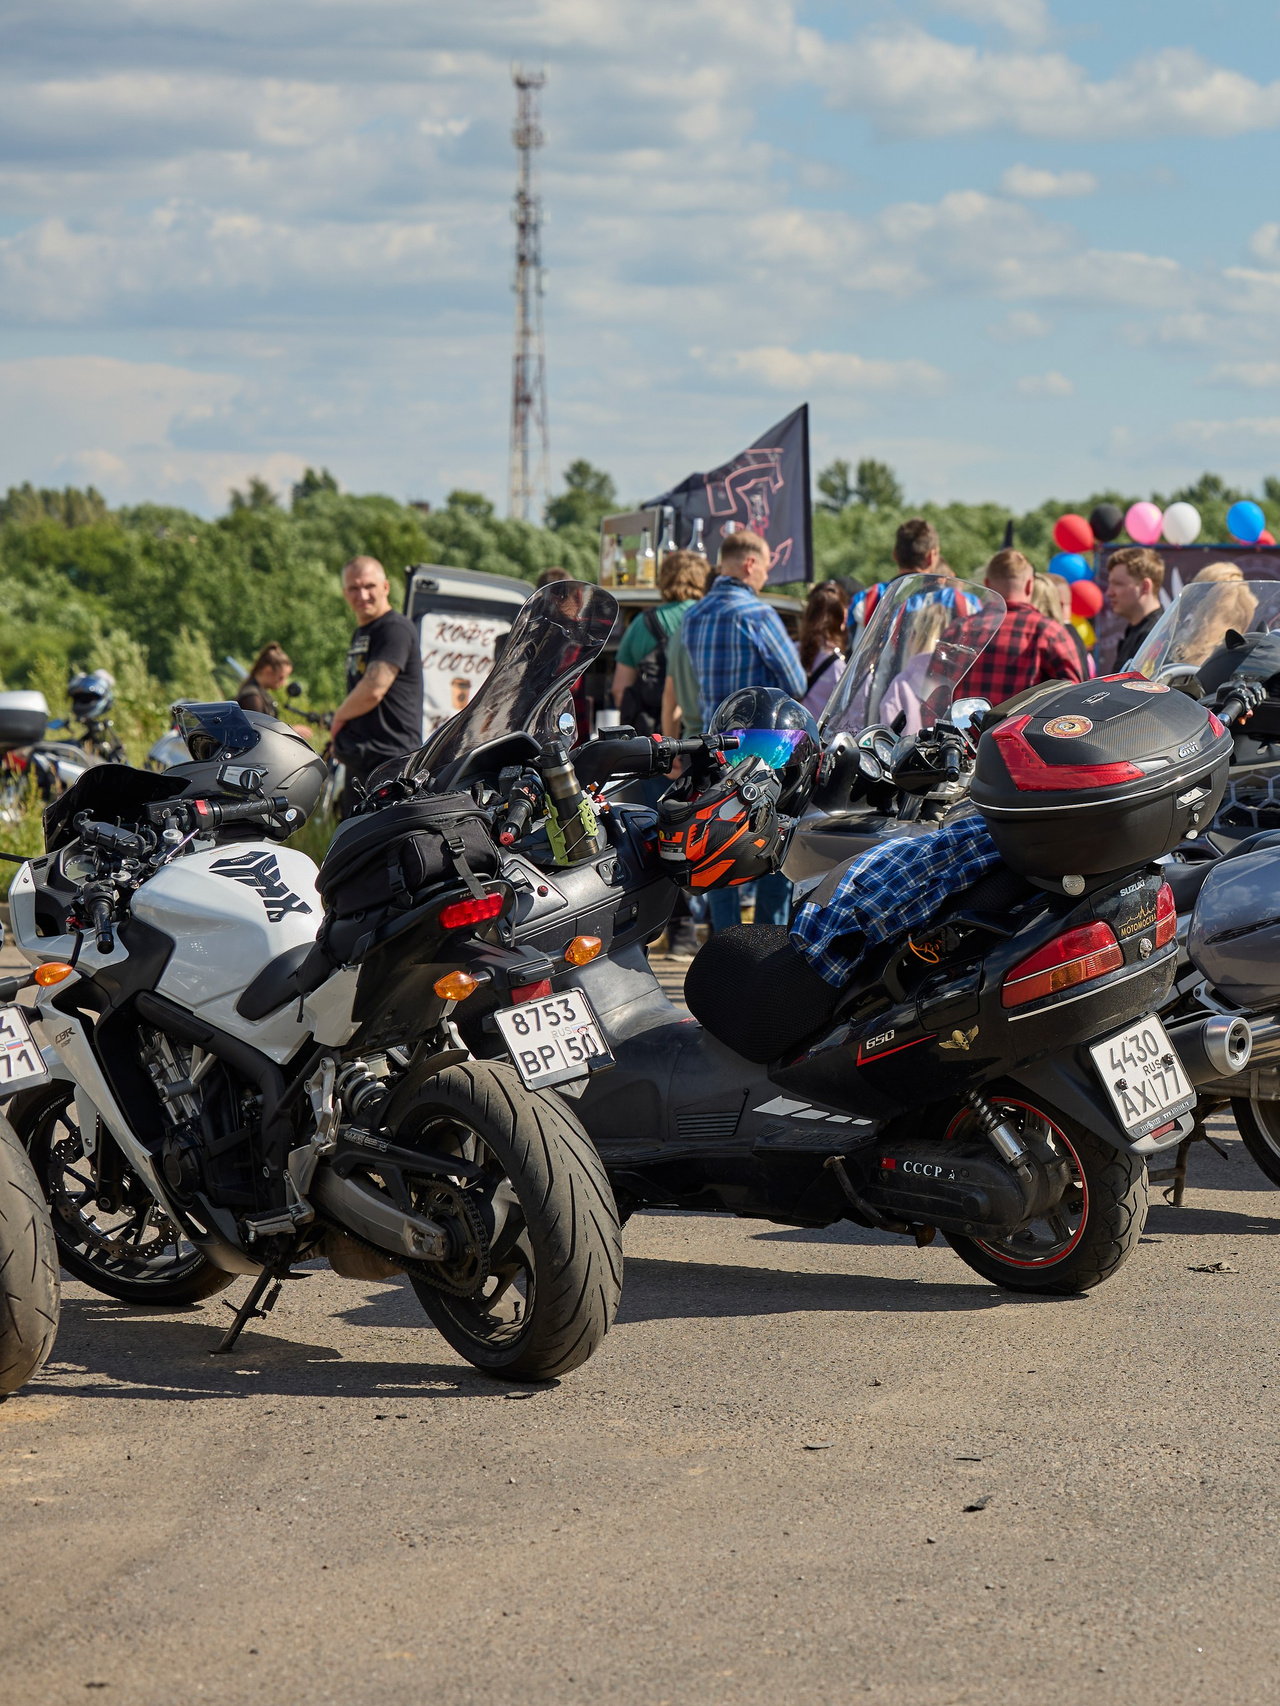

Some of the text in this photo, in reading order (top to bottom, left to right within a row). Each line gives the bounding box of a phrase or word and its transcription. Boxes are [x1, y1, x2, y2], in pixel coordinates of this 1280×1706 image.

[439, 650, 493, 674] СОБО
[1120, 880, 1145, 897] SUZUKI
[512, 998, 576, 1036] 8753
[55, 1027, 76, 1045] CBR
[551, 1026, 572, 1039] RUS
[866, 1029, 895, 1050] 650
[564, 1033, 599, 1061] 50
[1109, 1029, 1160, 1074] 4430
[1142, 1059, 1161, 1076] RUS
[1152, 1064, 1181, 1102] 77
